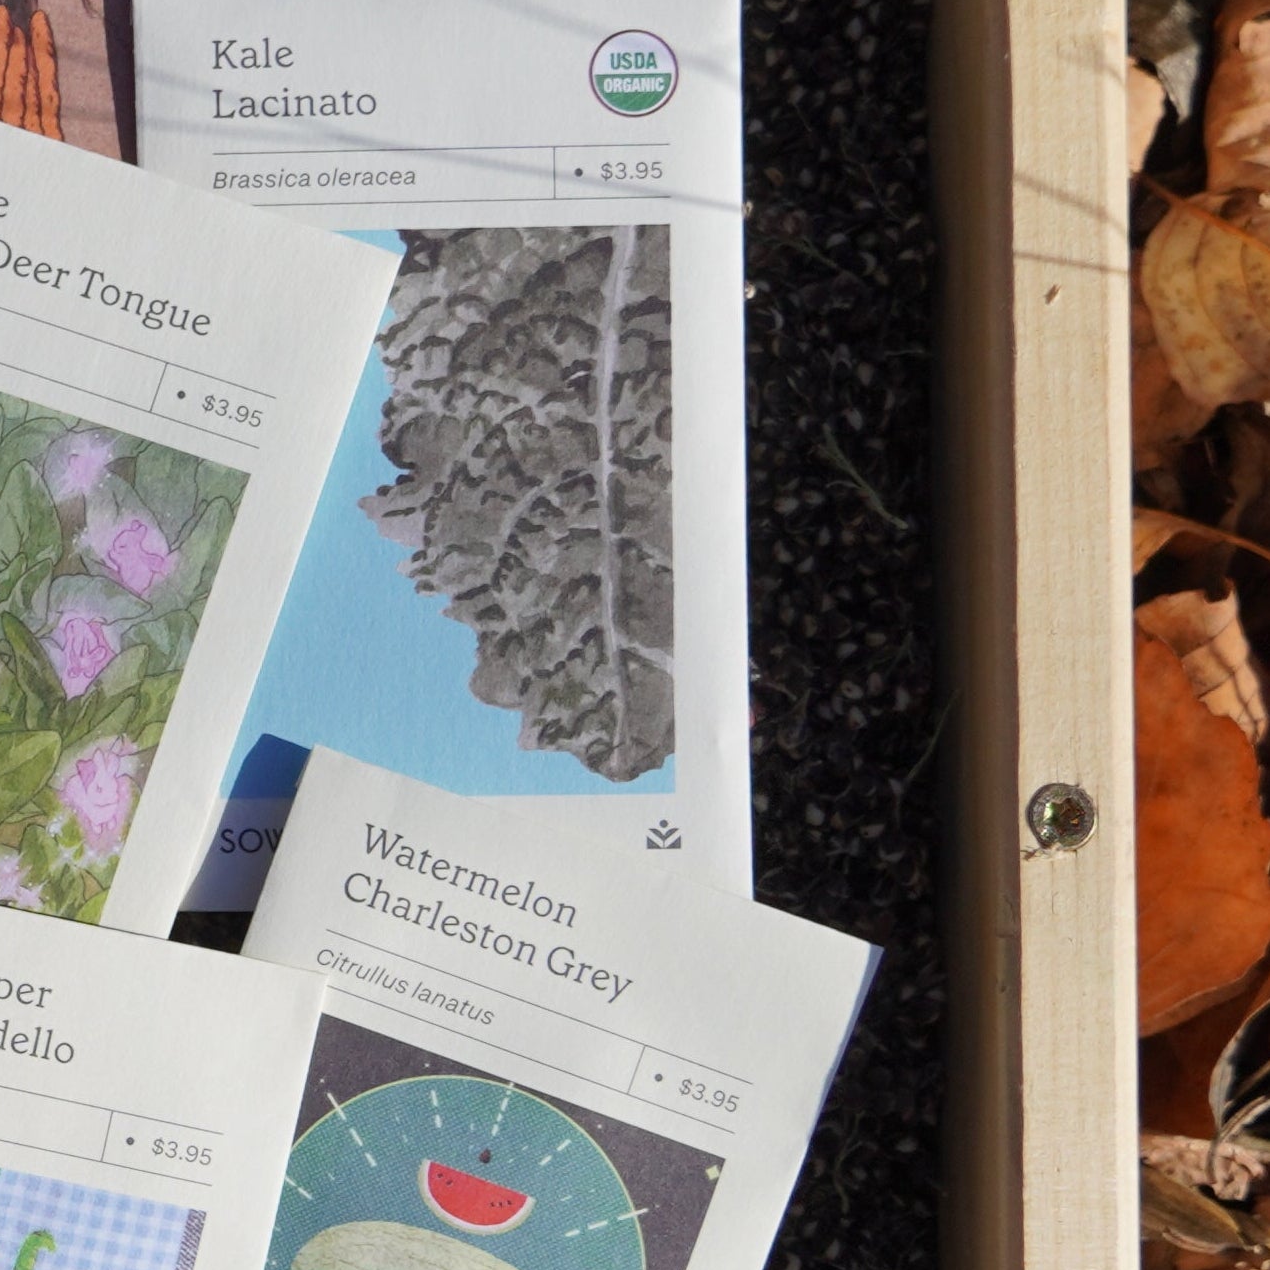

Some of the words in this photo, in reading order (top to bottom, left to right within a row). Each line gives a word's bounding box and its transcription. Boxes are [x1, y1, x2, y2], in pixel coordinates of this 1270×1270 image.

[211, 36, 294, 70] Kale
[610, 51, 658, 70] USDA
[603, 76, 665, 94] ORGANIC
[211, 87, 377, 119] Lacinato
[212, 168, 312, 190] Brassica
[316, 167, 416, 187] oleracea
[600, 161, 663, 185] $3.95
[79, 266, 211, 337] Tongue
[201, 394, 264, 428] $3.95
[365, 822, 576, 929] Watermelon
[343, 872, 537, 967] Charleston
[546, 946, 634, 1004] Grey
[316, 948, 410, 994] Citrullus
[411, 981, 495, 1025] lanatus
[678, 1078, 741, 1113] $3.95
[151, 1137, 213, 1166] $3.95
